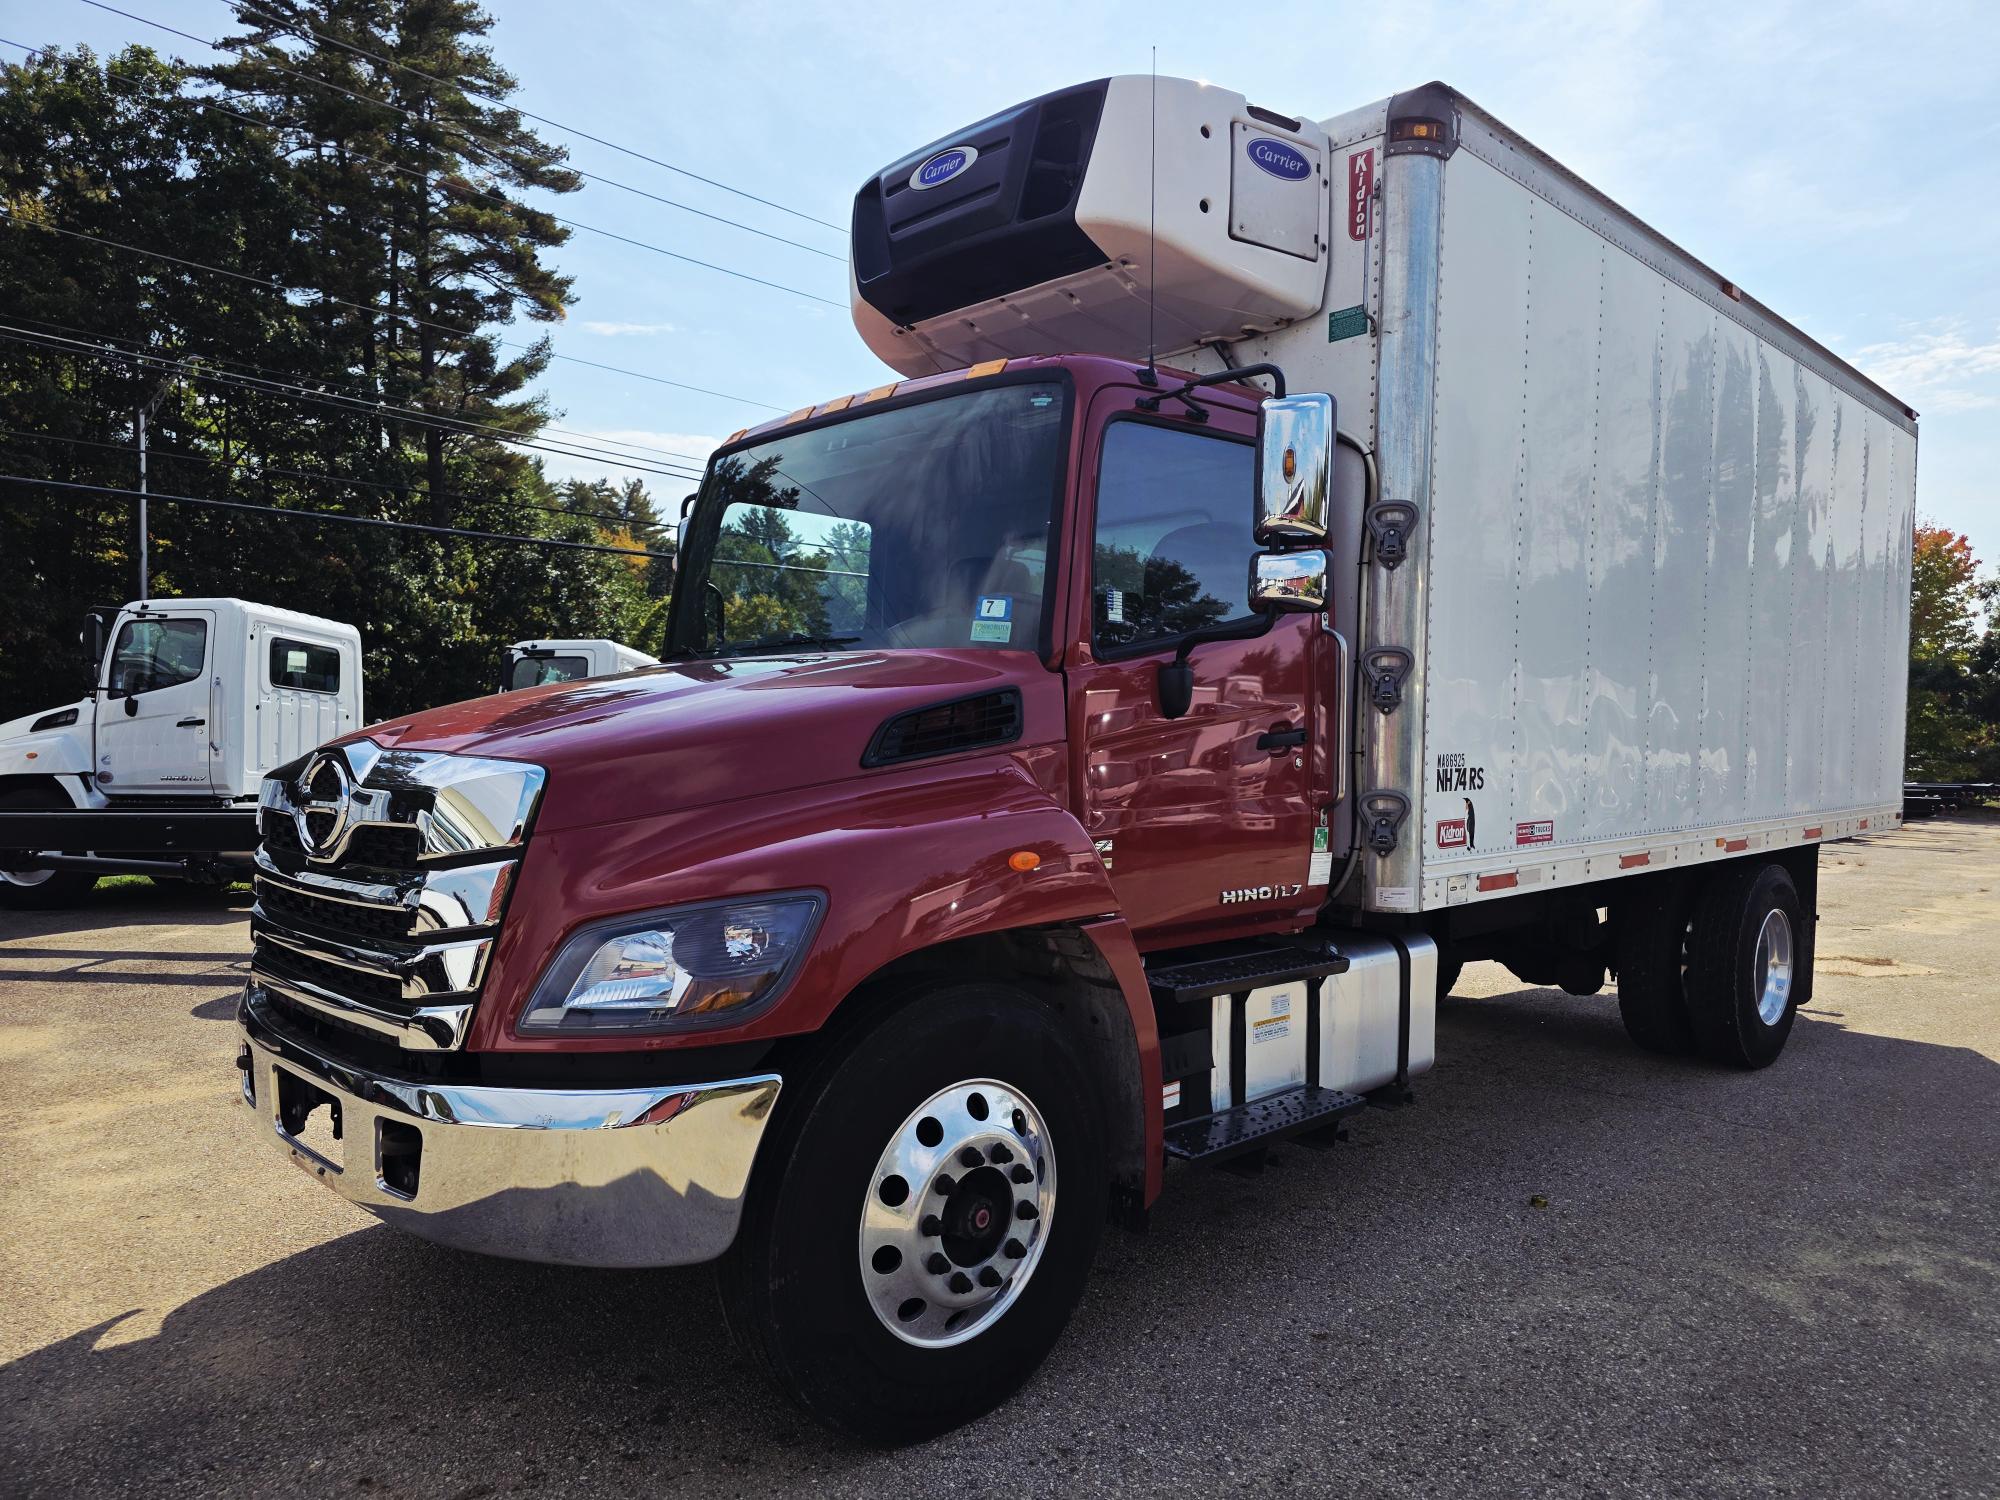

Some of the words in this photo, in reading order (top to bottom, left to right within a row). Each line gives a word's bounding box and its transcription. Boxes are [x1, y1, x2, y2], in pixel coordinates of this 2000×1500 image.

[925, 158, 961, 180] Carrier
[1256, 144, 1303, 172] Carrier
[1354, 154, 1368, 236] Kidron
[986, 600, 995, 614] 7
[1440, 825, 1464, 843] Kidron
